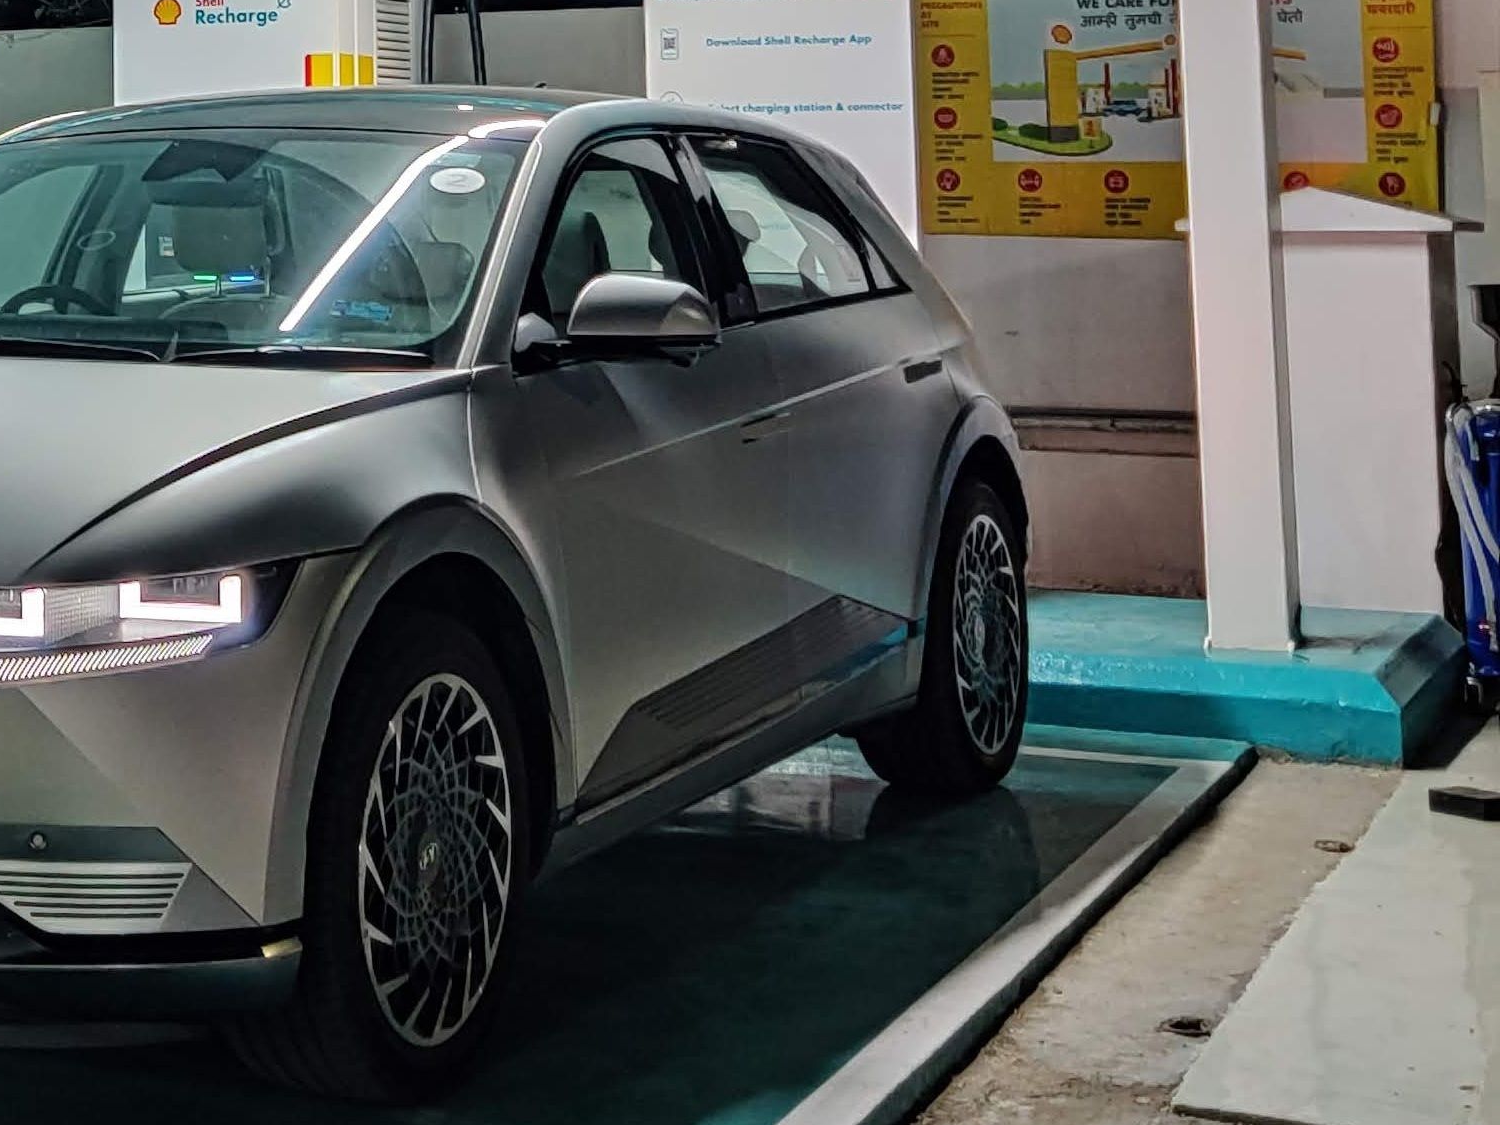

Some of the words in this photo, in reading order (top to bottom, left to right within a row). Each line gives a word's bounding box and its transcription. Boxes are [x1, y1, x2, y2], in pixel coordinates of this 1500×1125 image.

[195, 7, 278, 27] Recharge
[706, 37, 762, 47] Download
[764, 36, 791, 45] Shell
[794, 35, 846, 45] Recharge
[849, 34, 873, 45] App
[742, 102, 791, 115] charging
[793, 102, 833, 112] station
[836, 102, 844, 112] &
[847, 102, 904, 112] connector
